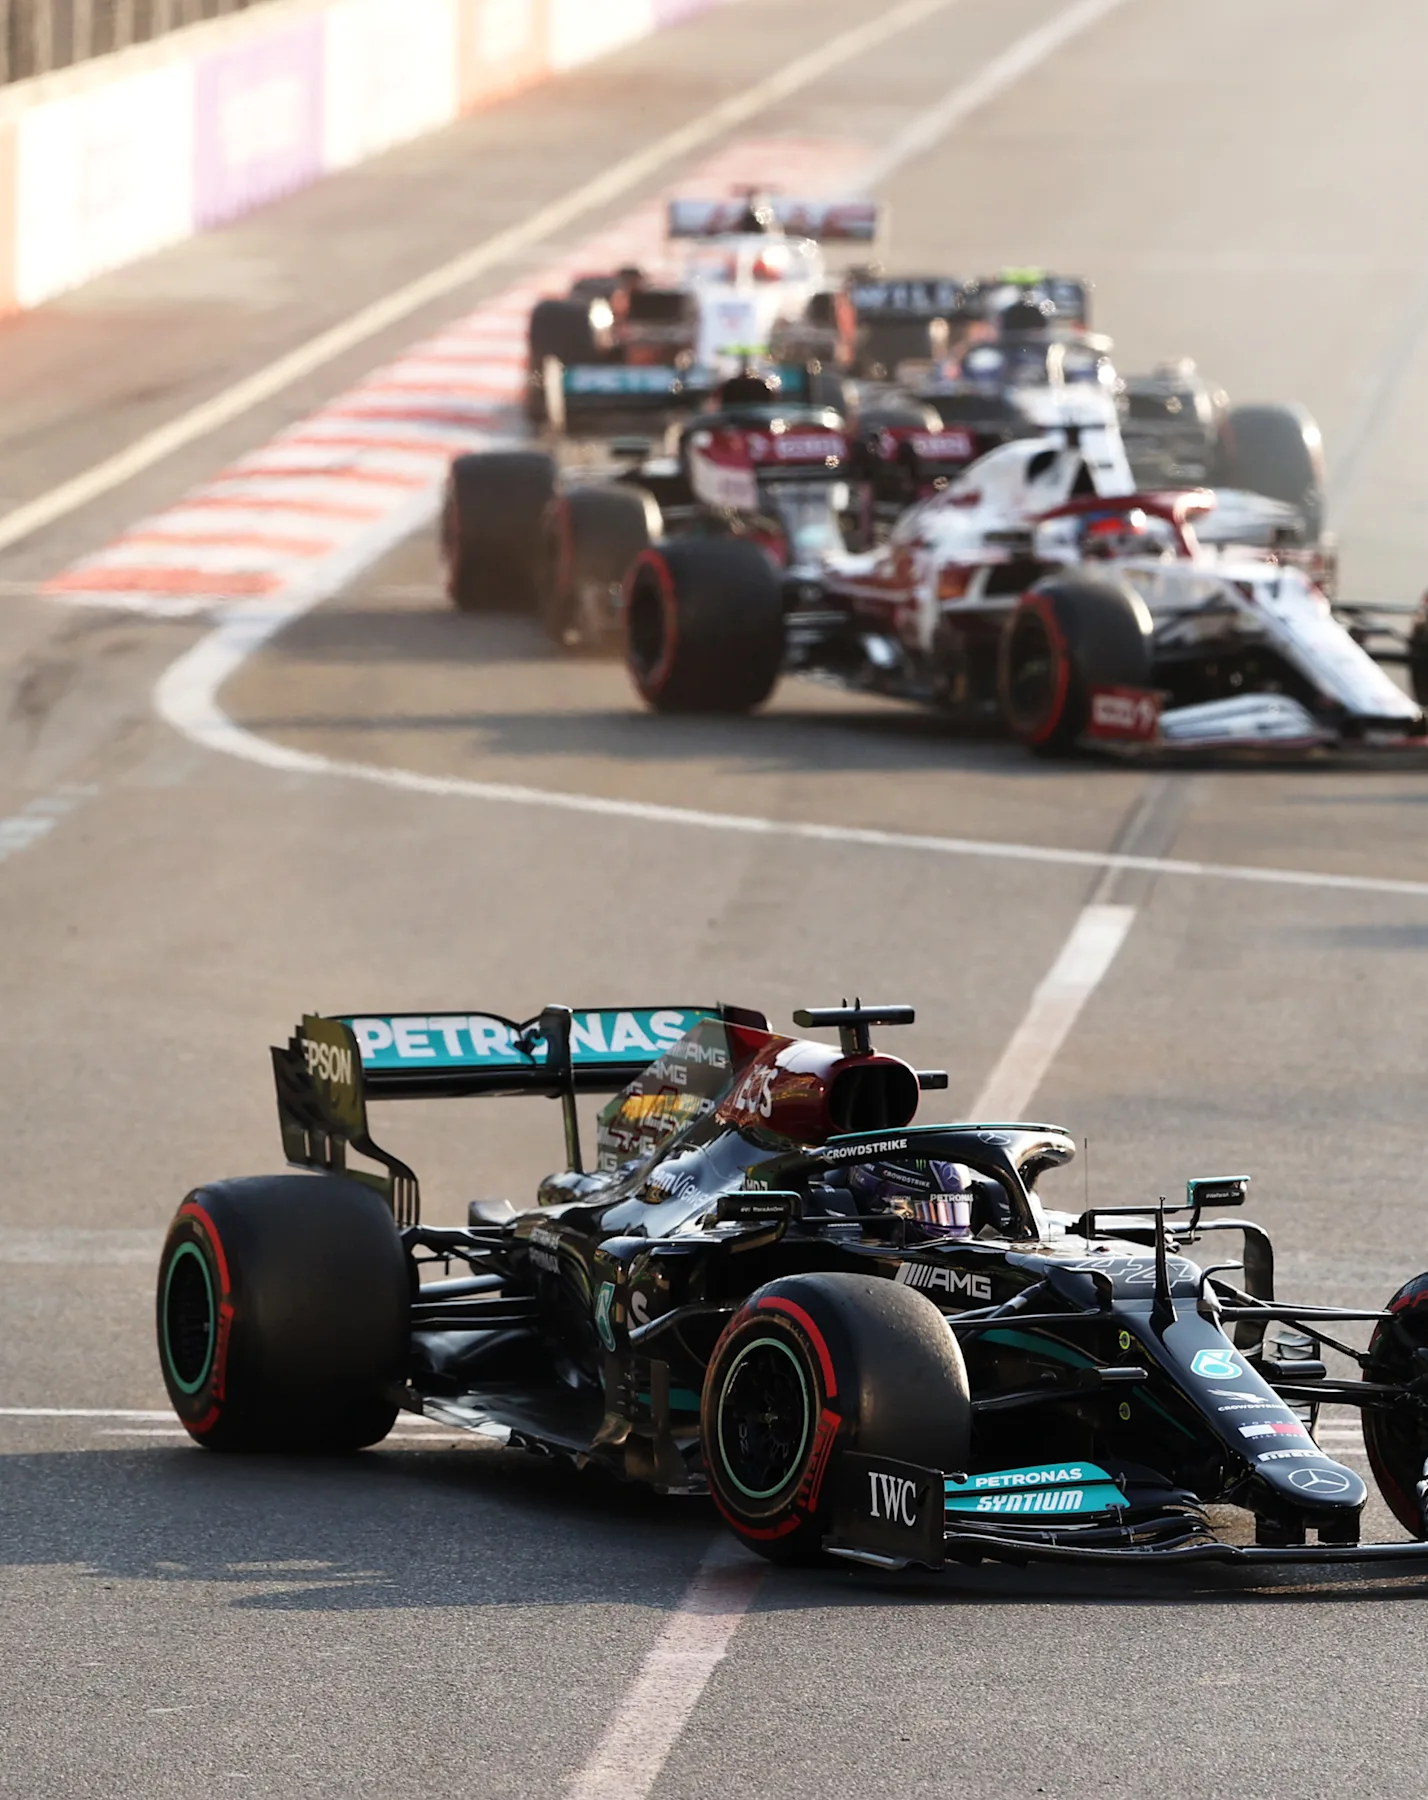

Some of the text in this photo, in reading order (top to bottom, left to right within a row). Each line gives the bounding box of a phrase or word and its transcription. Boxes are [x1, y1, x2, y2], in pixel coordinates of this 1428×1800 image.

[827, 1138, 908, 1160] CROWDSTRIKE
[882, 1169, 931, 1188] CROWDSTRIKE
[975, 1467, 1082, 1488] PETRONAS
[867, 1471, 917, 1527] IWC
[976, 1490, 1083, 1512] SYNTIUM
